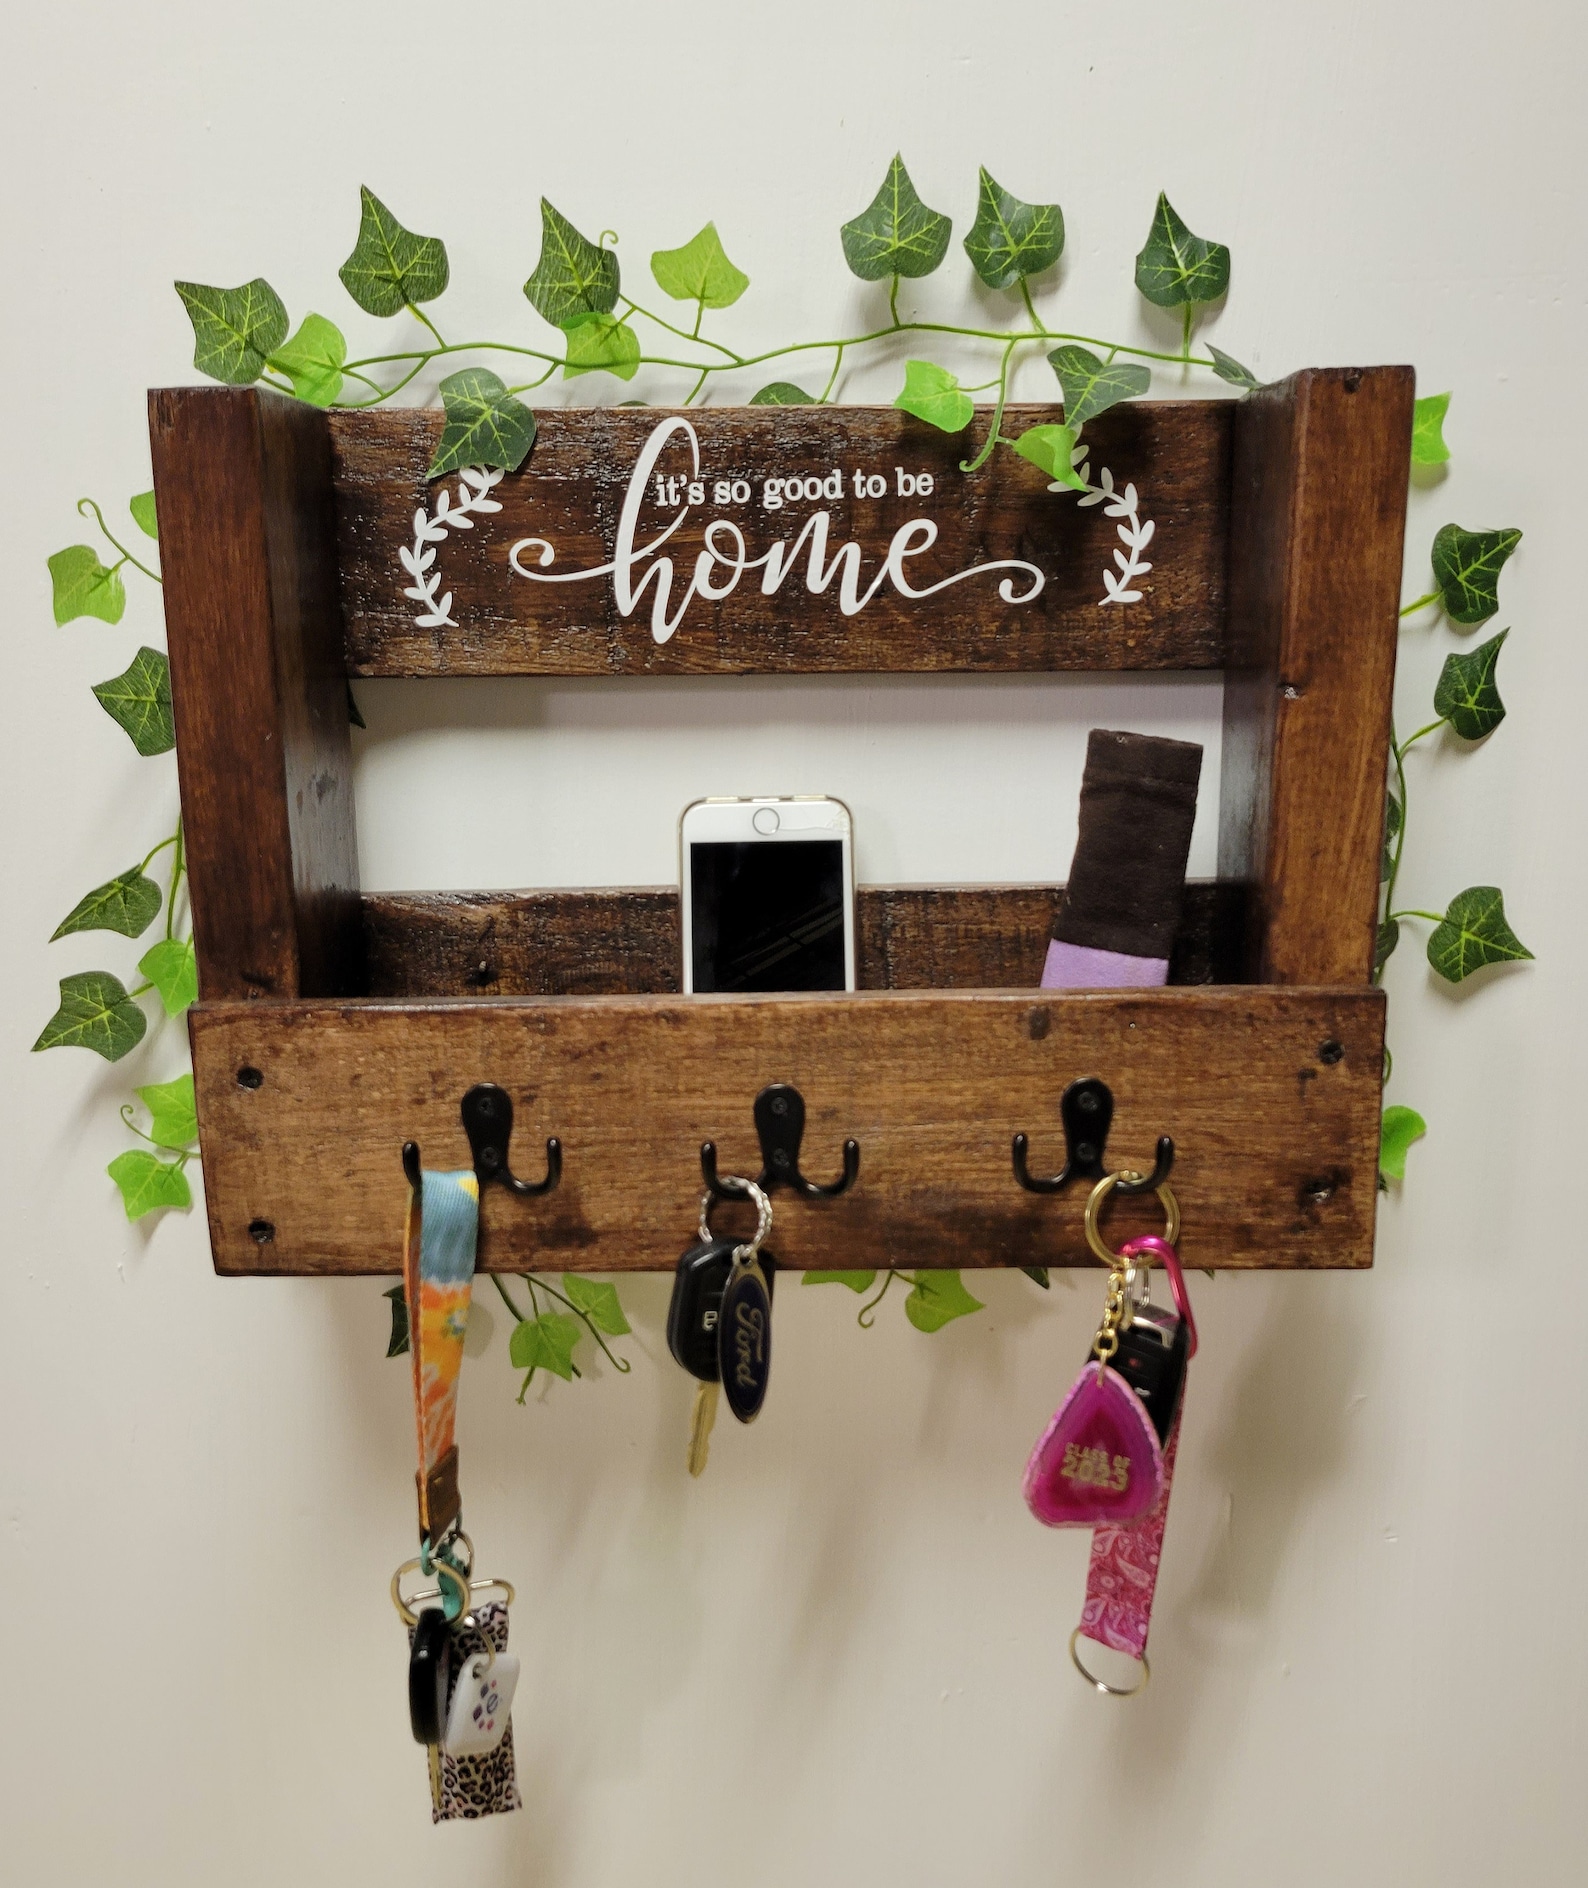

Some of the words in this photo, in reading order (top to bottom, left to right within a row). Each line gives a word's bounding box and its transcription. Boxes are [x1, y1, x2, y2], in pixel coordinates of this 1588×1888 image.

[655, 474, 706, 507] it's
[714, 479, 752, 504] so
[762, 469, 845, 511] good
[852, 468, 888, 499] to
[895, 466, 935, 498] be
[509, 416, 1045, 645] home
[736, 1302, 763, 1387] Ford
[1061, 1455, 1128, 1491] 2023
[1065, 1442, 1108, 1463] CLASS
[1113, 1455, 1130, 1468] OF
